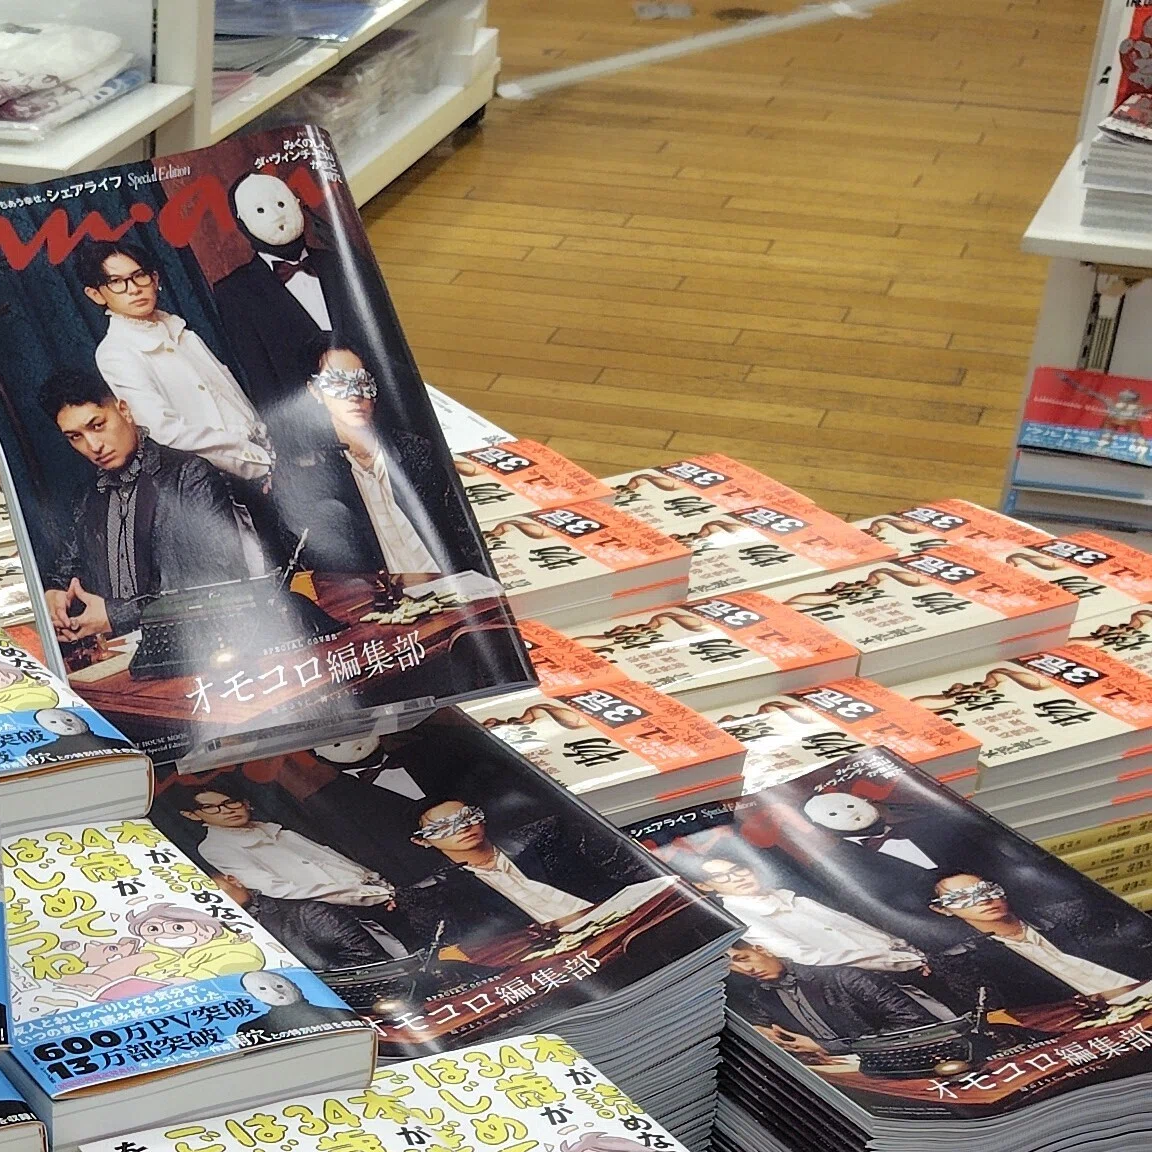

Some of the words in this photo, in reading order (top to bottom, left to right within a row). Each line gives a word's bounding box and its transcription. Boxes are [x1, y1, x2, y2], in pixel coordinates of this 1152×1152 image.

[45, 175, 123, 203] シェアライフ
[127, 169, 157, 190] Special
[475, 446, 534, 473] 3冠
[548, 509, 602, 535] 3冠
[913, 557, 977, 583] 3冠
[698, 600, 760, 628] 3冠
[186, 629, 426, 715] オモコロ編集部
[1029, 654, 1100, 685] 3冠
[581, 690, 644, 724] 3冠
[629, 811, 697, 840] シェアライフ
[45, 830, 146, 899] 34歳が
[106, 821, 253, 933] 本が読めない
[32, 998, 258, 1060] 600万PV突破
[926, 1022, 1152, 1100] オモコロ編集部
[462, 1044, 573, 1125] 34歳が
